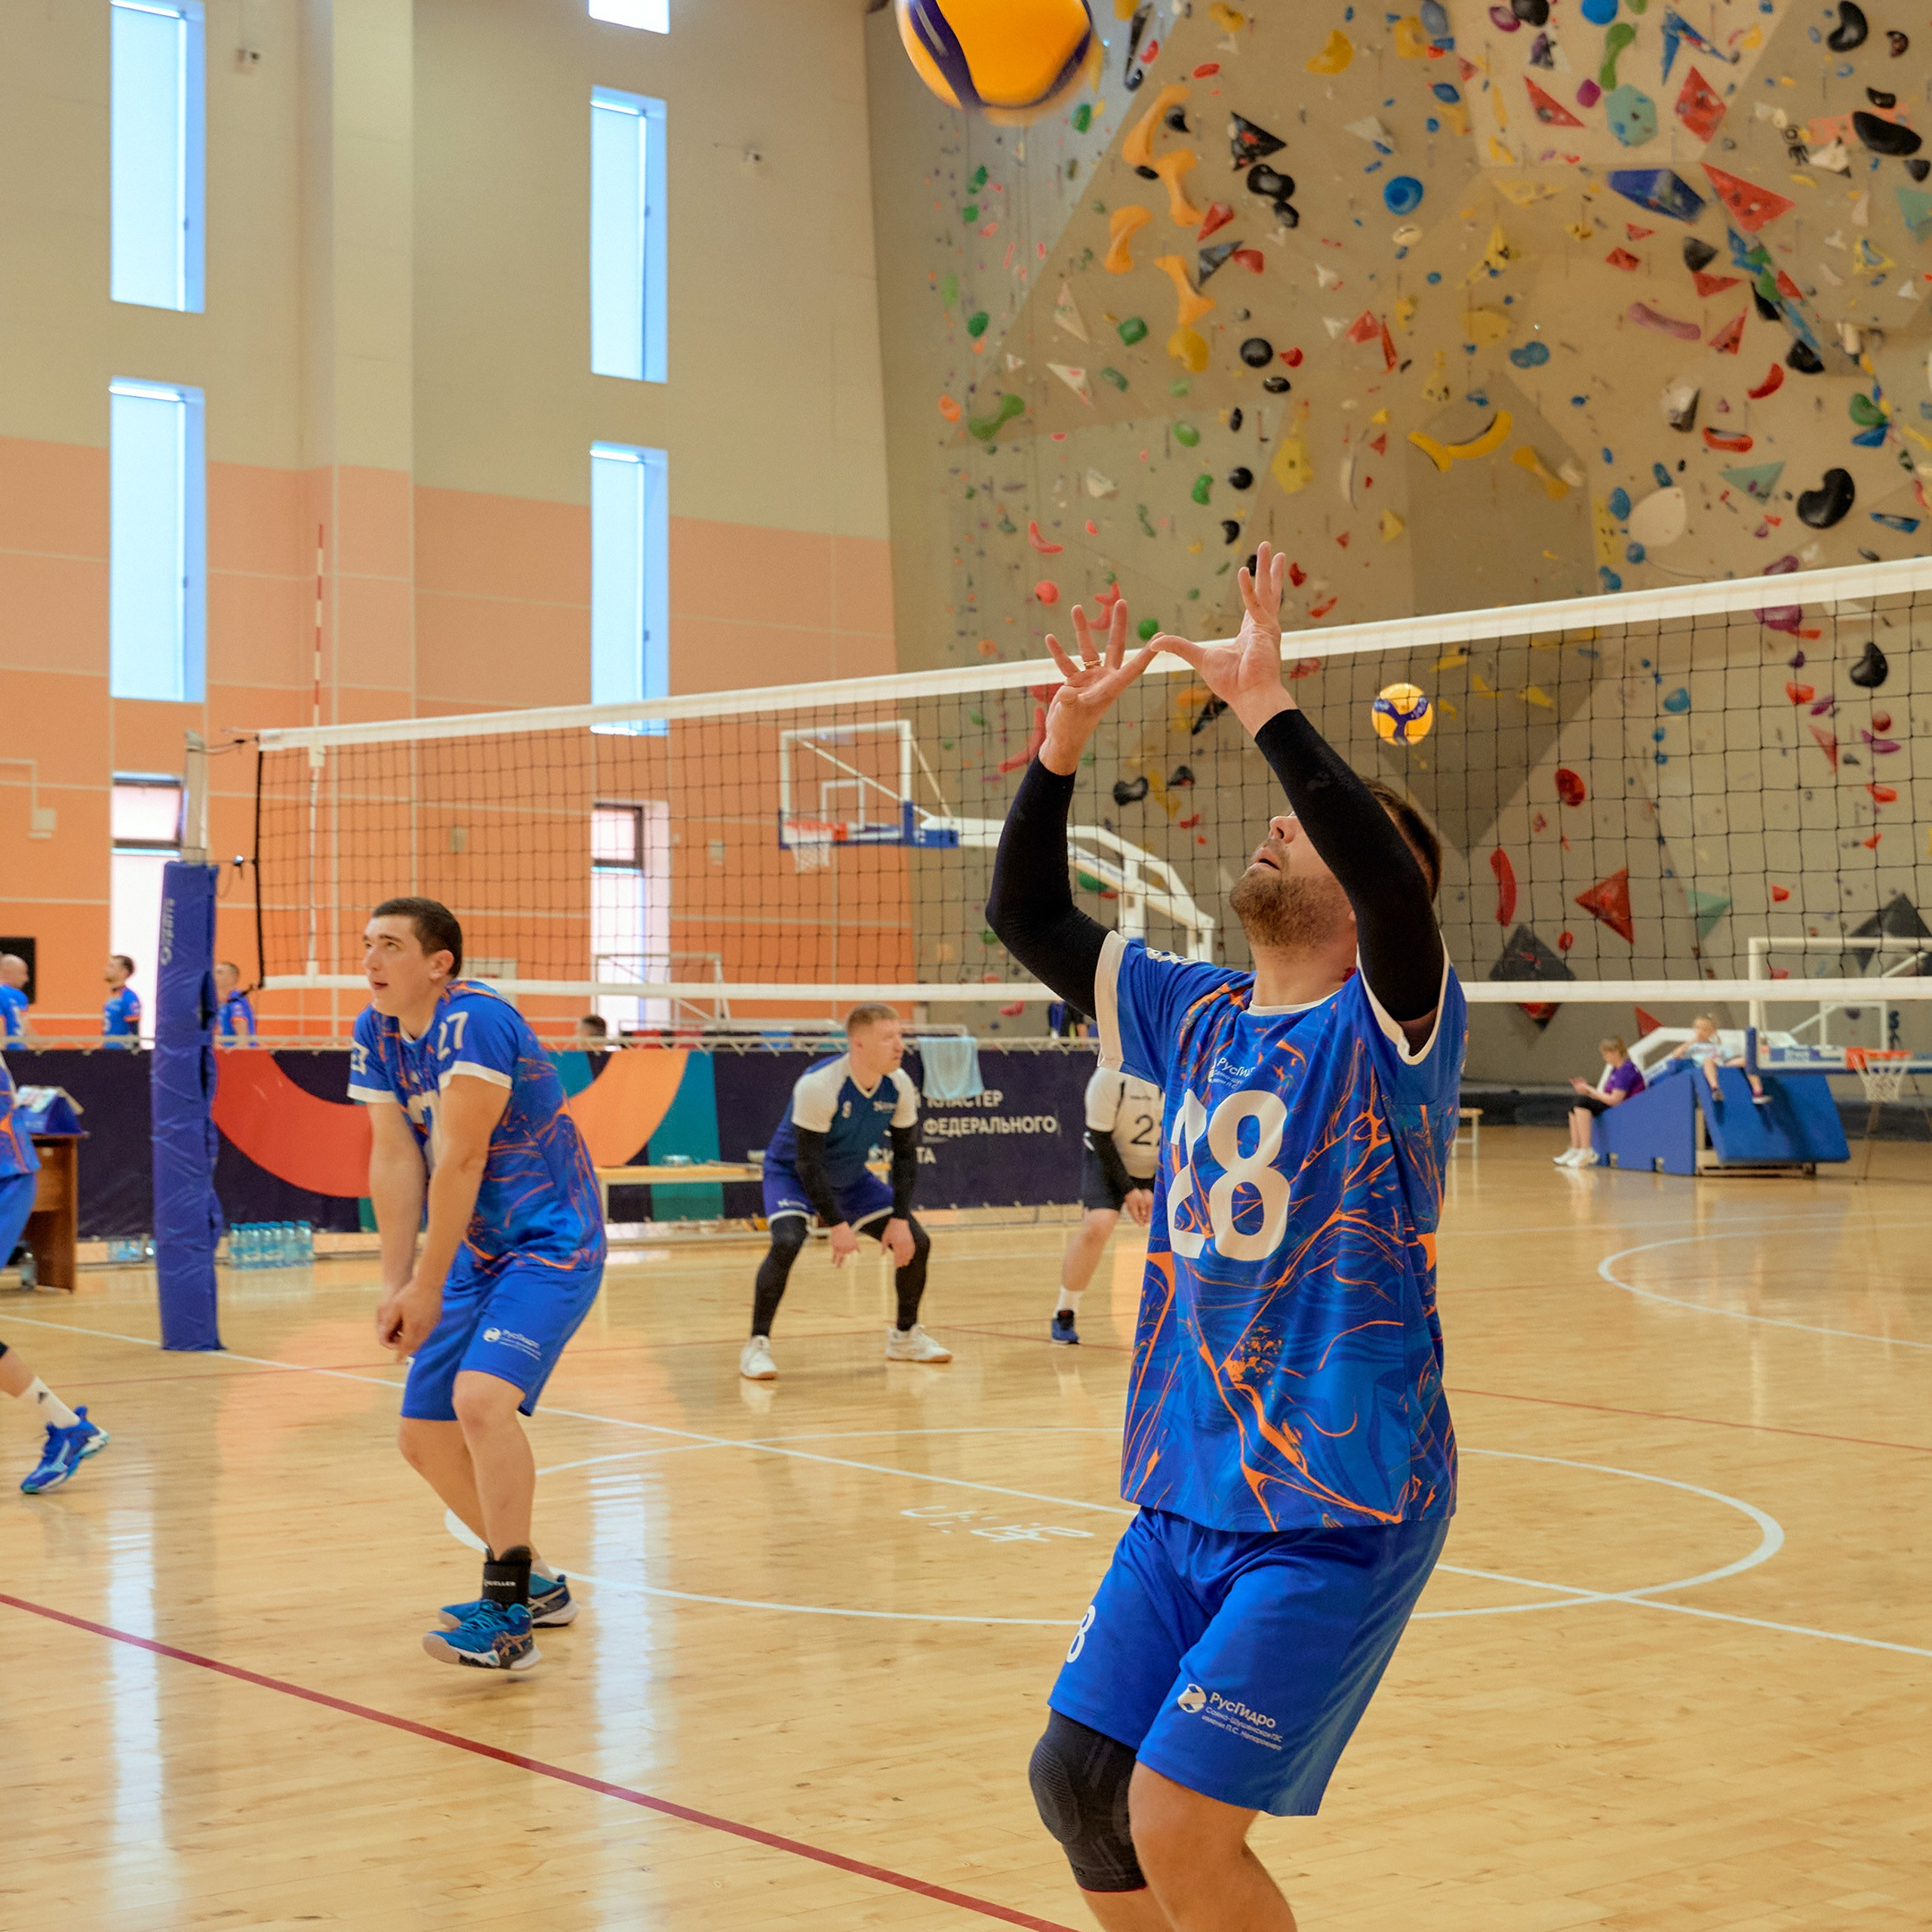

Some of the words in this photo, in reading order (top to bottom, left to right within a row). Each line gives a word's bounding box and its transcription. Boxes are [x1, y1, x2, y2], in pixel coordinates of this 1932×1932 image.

[437, 1011, 469, 1060] 27
[922, 1115, 1057, 1137] ФЕДЕРАЛЬНОГО
[1130, 1113, 1162, 1146] 2
[1167, 1088, 1291, 1261] 28
[1210, 1691, 1276, 1729] РусГидро
